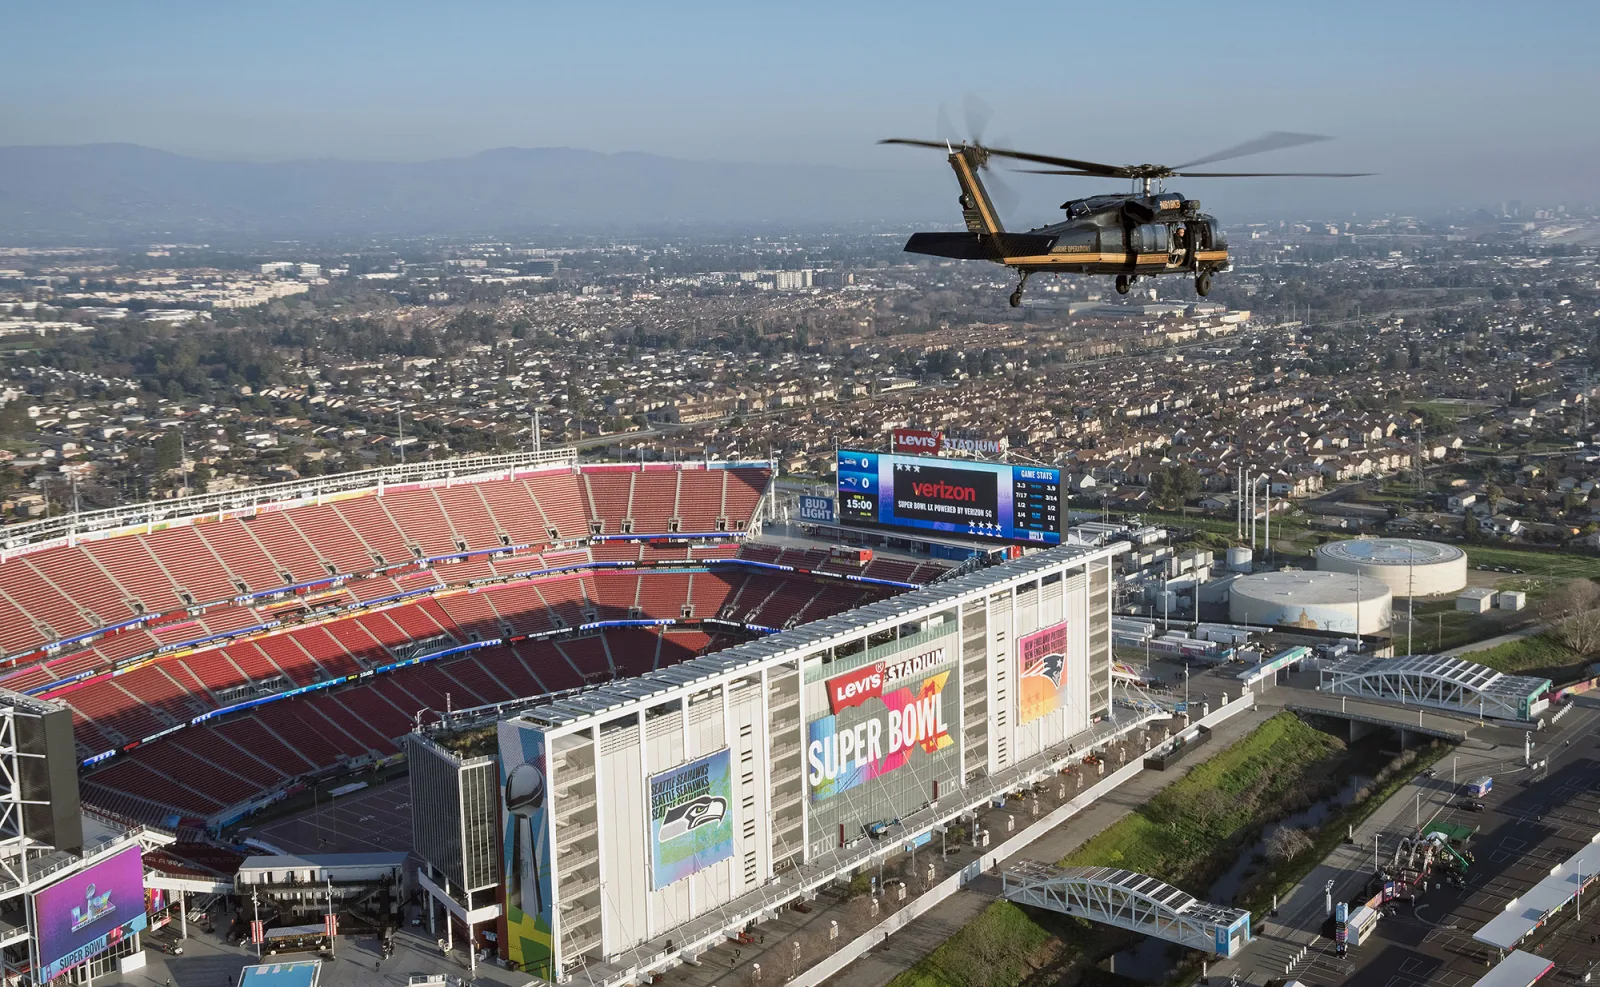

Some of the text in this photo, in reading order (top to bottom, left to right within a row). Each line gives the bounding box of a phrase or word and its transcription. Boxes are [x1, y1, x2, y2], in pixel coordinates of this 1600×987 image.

[899, 435, 998, 453] Levi's STADIUM
[861, 458, 869, 468] 0
[862, 477, 869, 488] 0
[1021, 470, 1053, 480] GAME STATS
[912, 480, 976, 502] verizon
[805, 498, 828, 510] BUD
[846, 499, 873, 510] 15:00
[898, 500, 992, 518] SUPER BOWL LX POWERED BY VERIZON 5G
[801, 507, 831, 520] LIGHT
[1024, 641, 1034, 652] NEW
[1034, 633, 1050, 650] ENGLAND
[1024, 650, 1034, 662] NEW
[837, 648, 946, 702] Levi's STADIUM
[808, 691, 948, 787] SUPER BOWL
[651, 763, 709, 796] SEATTLE SEAHAWKS
[651, 776, 709, 808] SEATTLE SEAHAWKS
[1218, 929, 1226, 944] B
[59, 948, 83, 971] SUPER
[84, 937, 106, 957] BOWL
